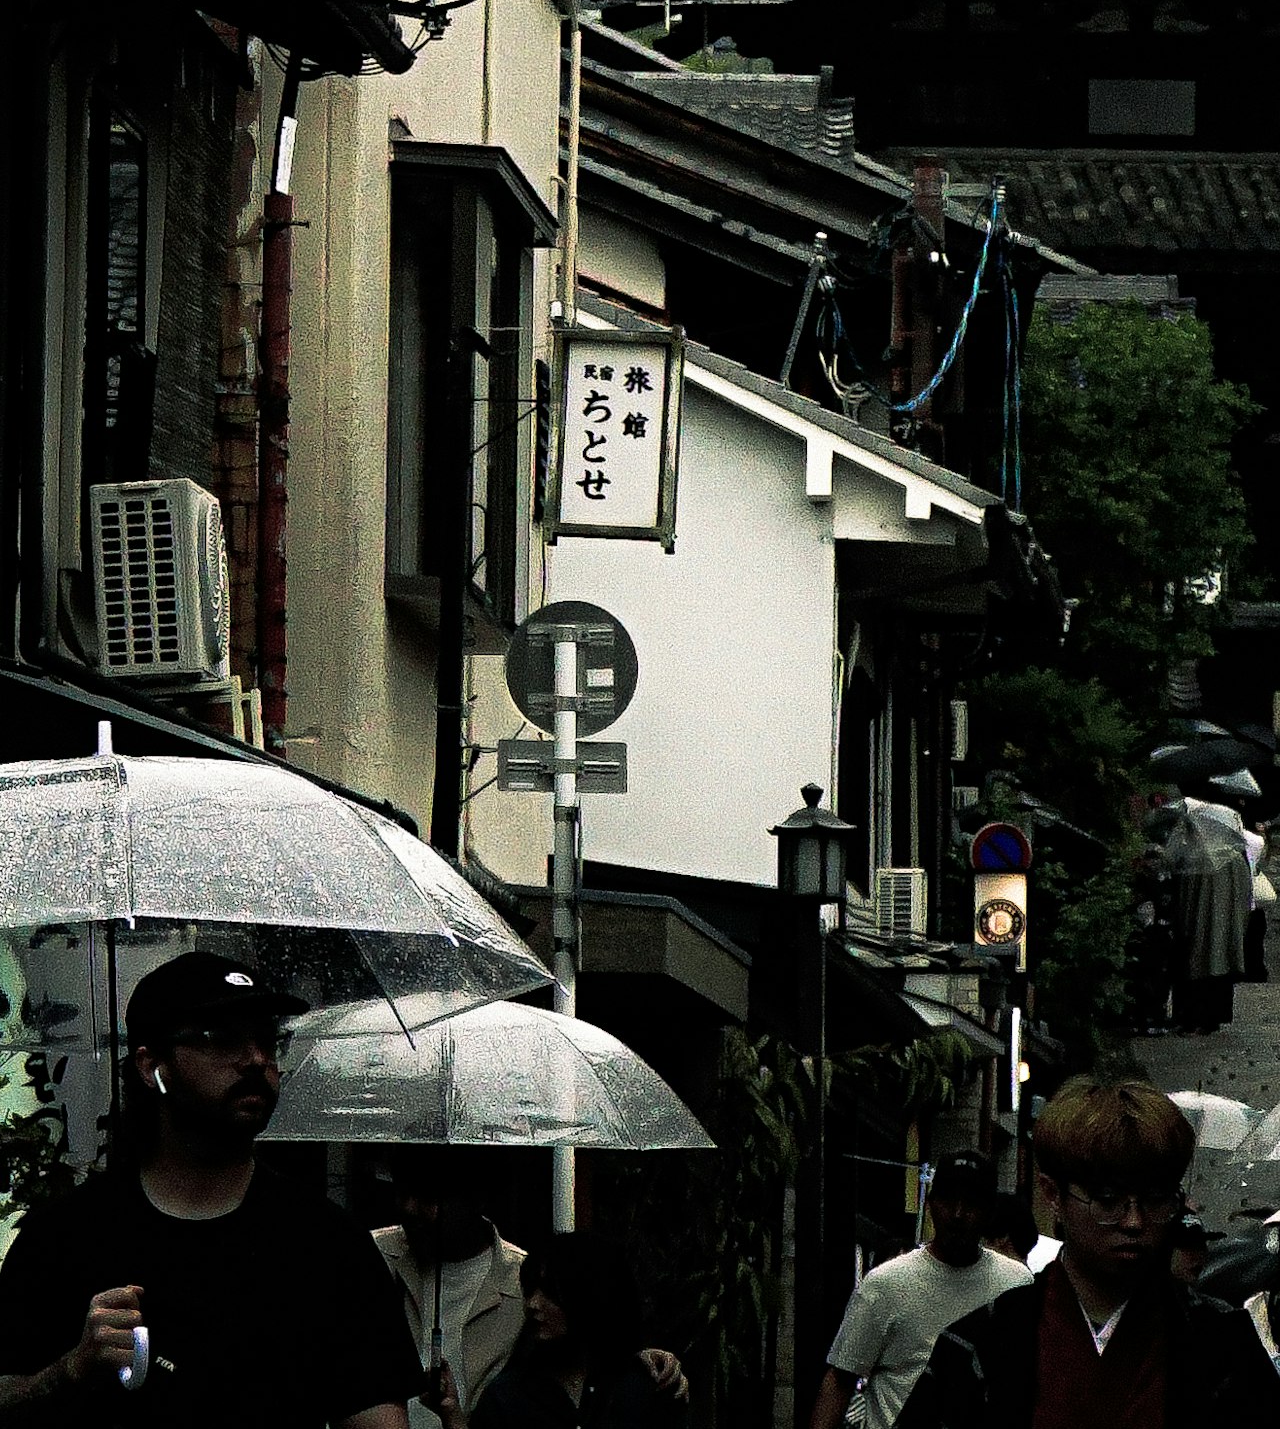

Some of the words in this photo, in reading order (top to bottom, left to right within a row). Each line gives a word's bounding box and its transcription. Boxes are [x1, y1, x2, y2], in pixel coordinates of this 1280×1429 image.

[574, 389, 613, 501] ちとせ
[622, 366, 654, 440] 旅館
